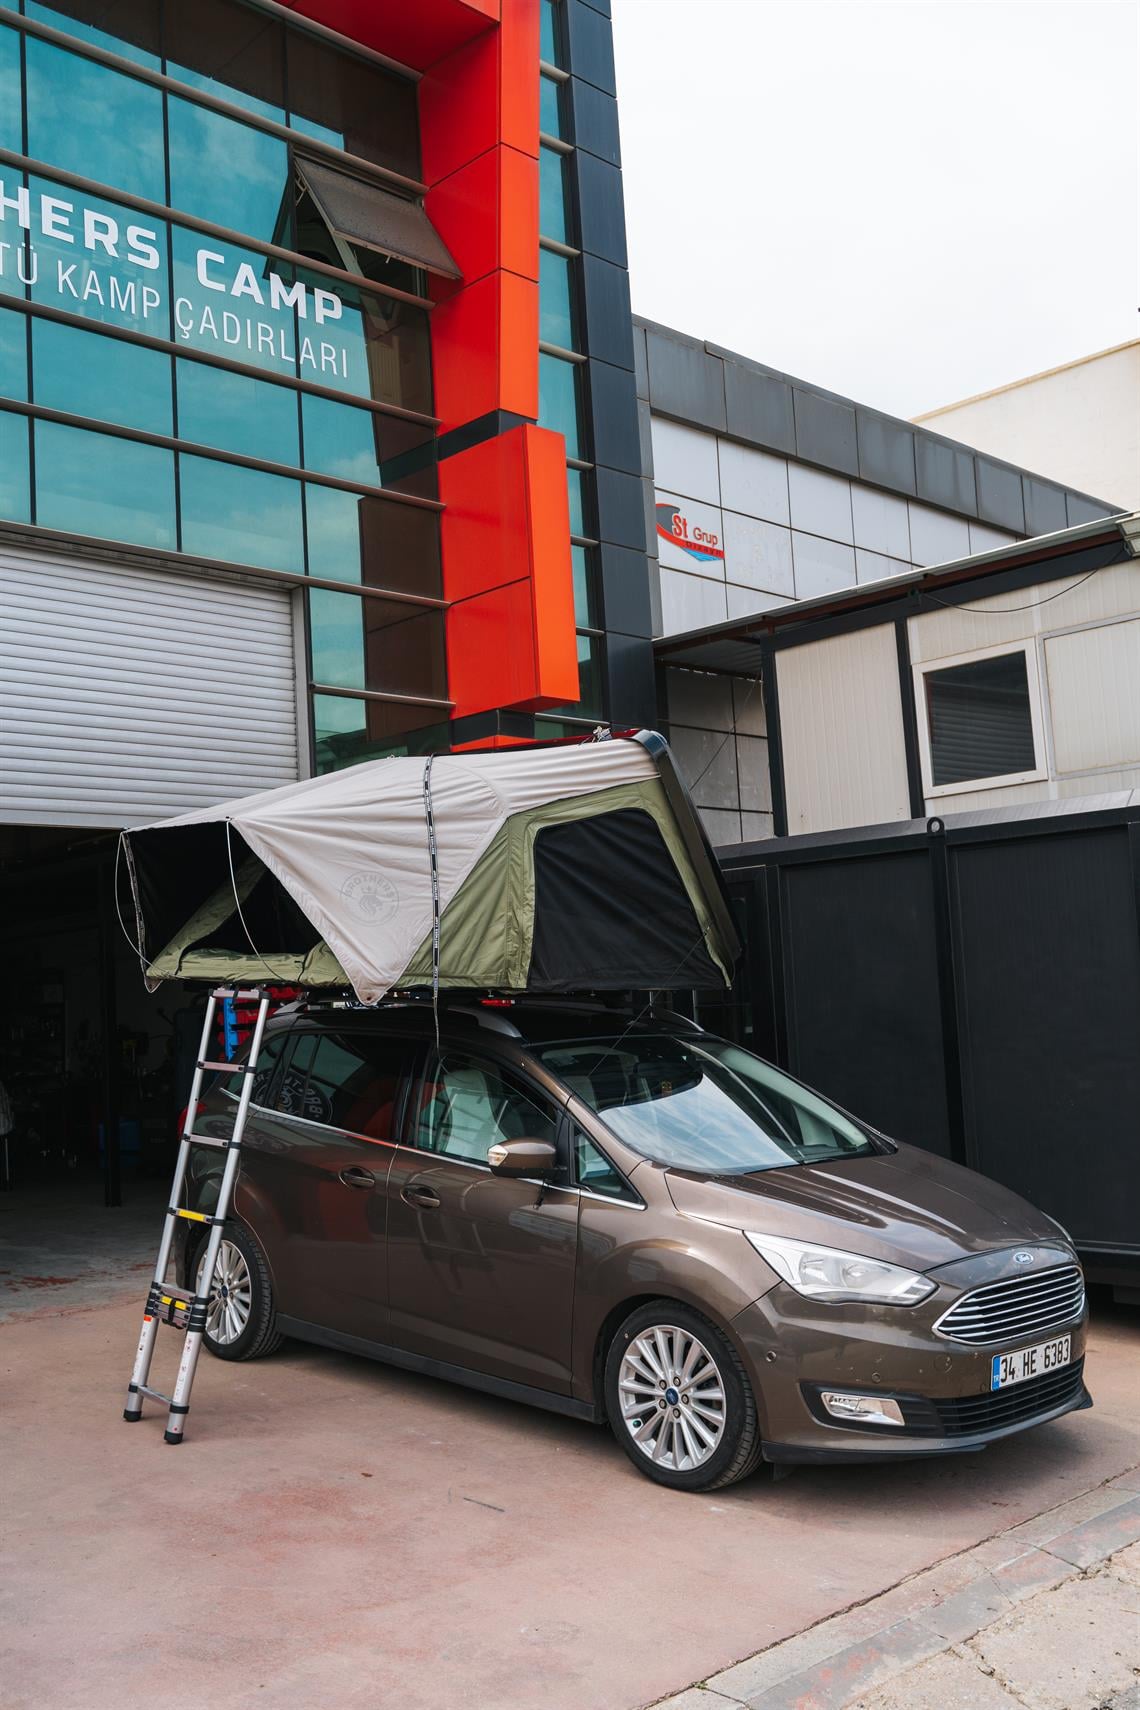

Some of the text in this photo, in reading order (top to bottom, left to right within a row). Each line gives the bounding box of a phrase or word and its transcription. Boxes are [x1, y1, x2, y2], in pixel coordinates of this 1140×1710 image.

[197, 249, 343, 325] CAMP
[58, 259, 161, 319] KAMP
[175, 297, 348, 378] ÇADIRLARI
[672, 513, 719, 548] St Grup
[1000, 1338, 1070, 1383] 34 HE 6383
